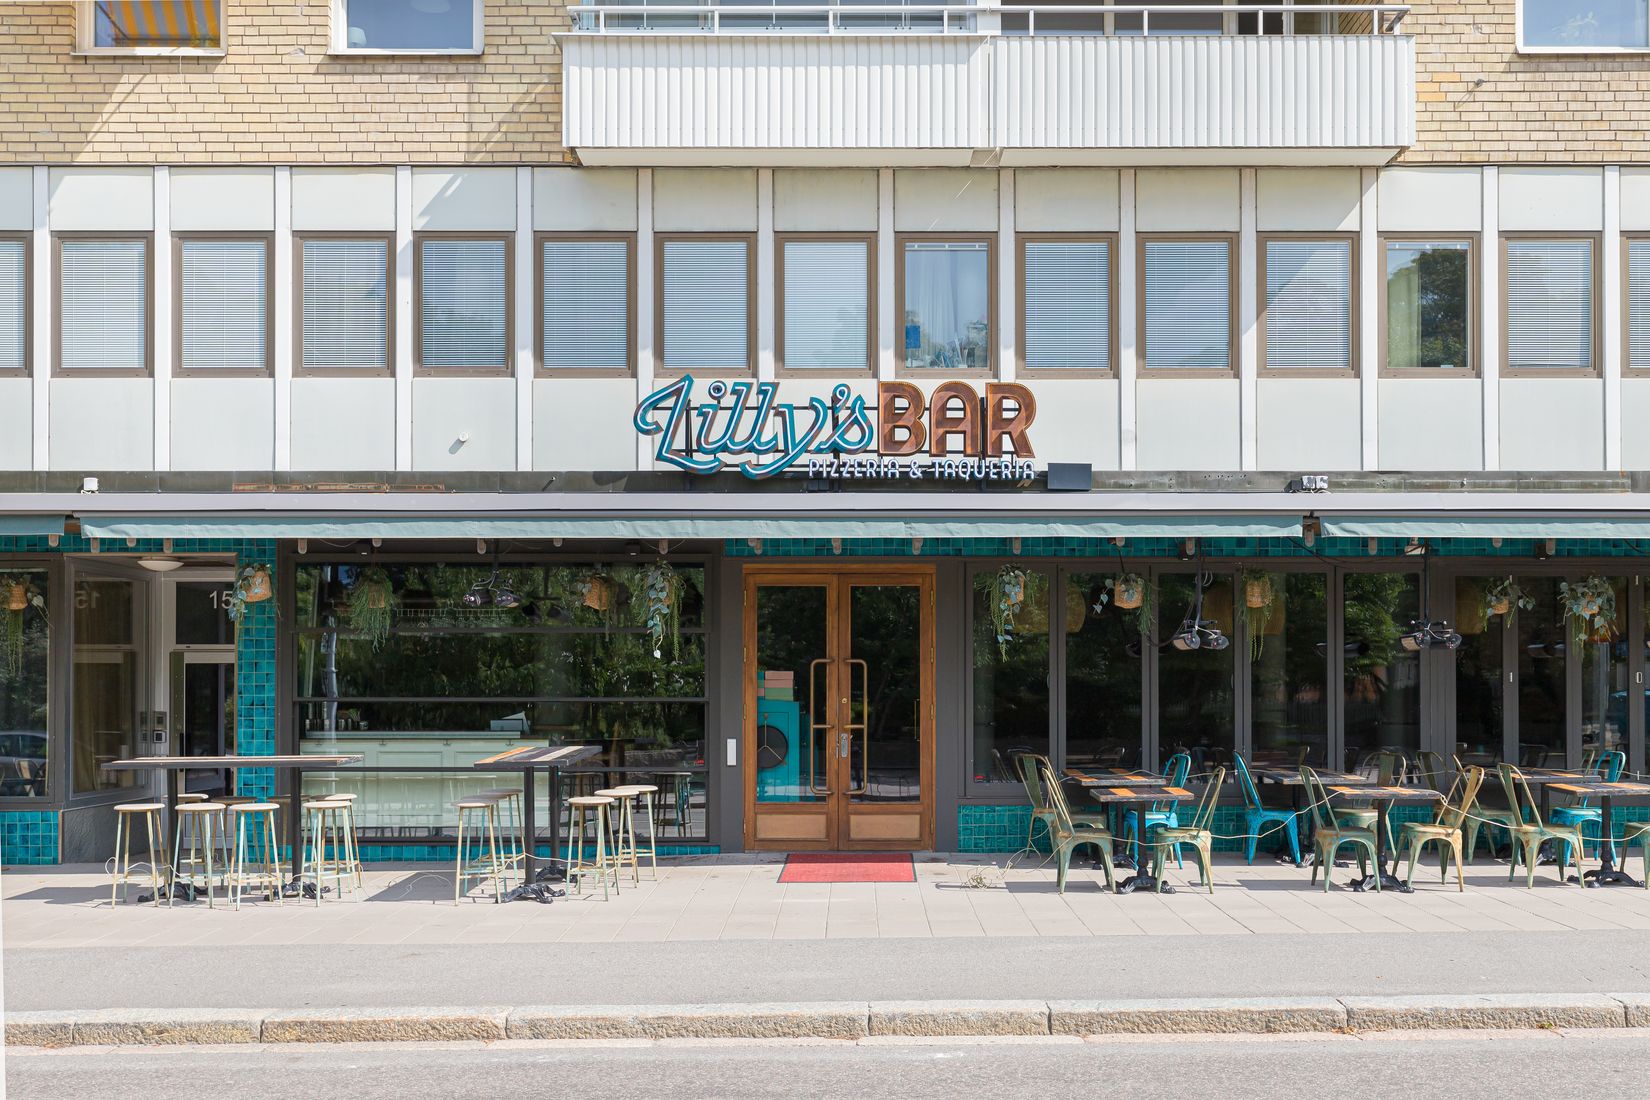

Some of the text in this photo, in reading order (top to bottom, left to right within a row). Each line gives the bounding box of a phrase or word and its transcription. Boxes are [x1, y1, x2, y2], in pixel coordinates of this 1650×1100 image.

[633, 374, 1037, 480] Lilly's BAR
[808, 458, 1035, 482] PIZZERIA & TAQUERIA
[209, 590, 234, 609] 15
